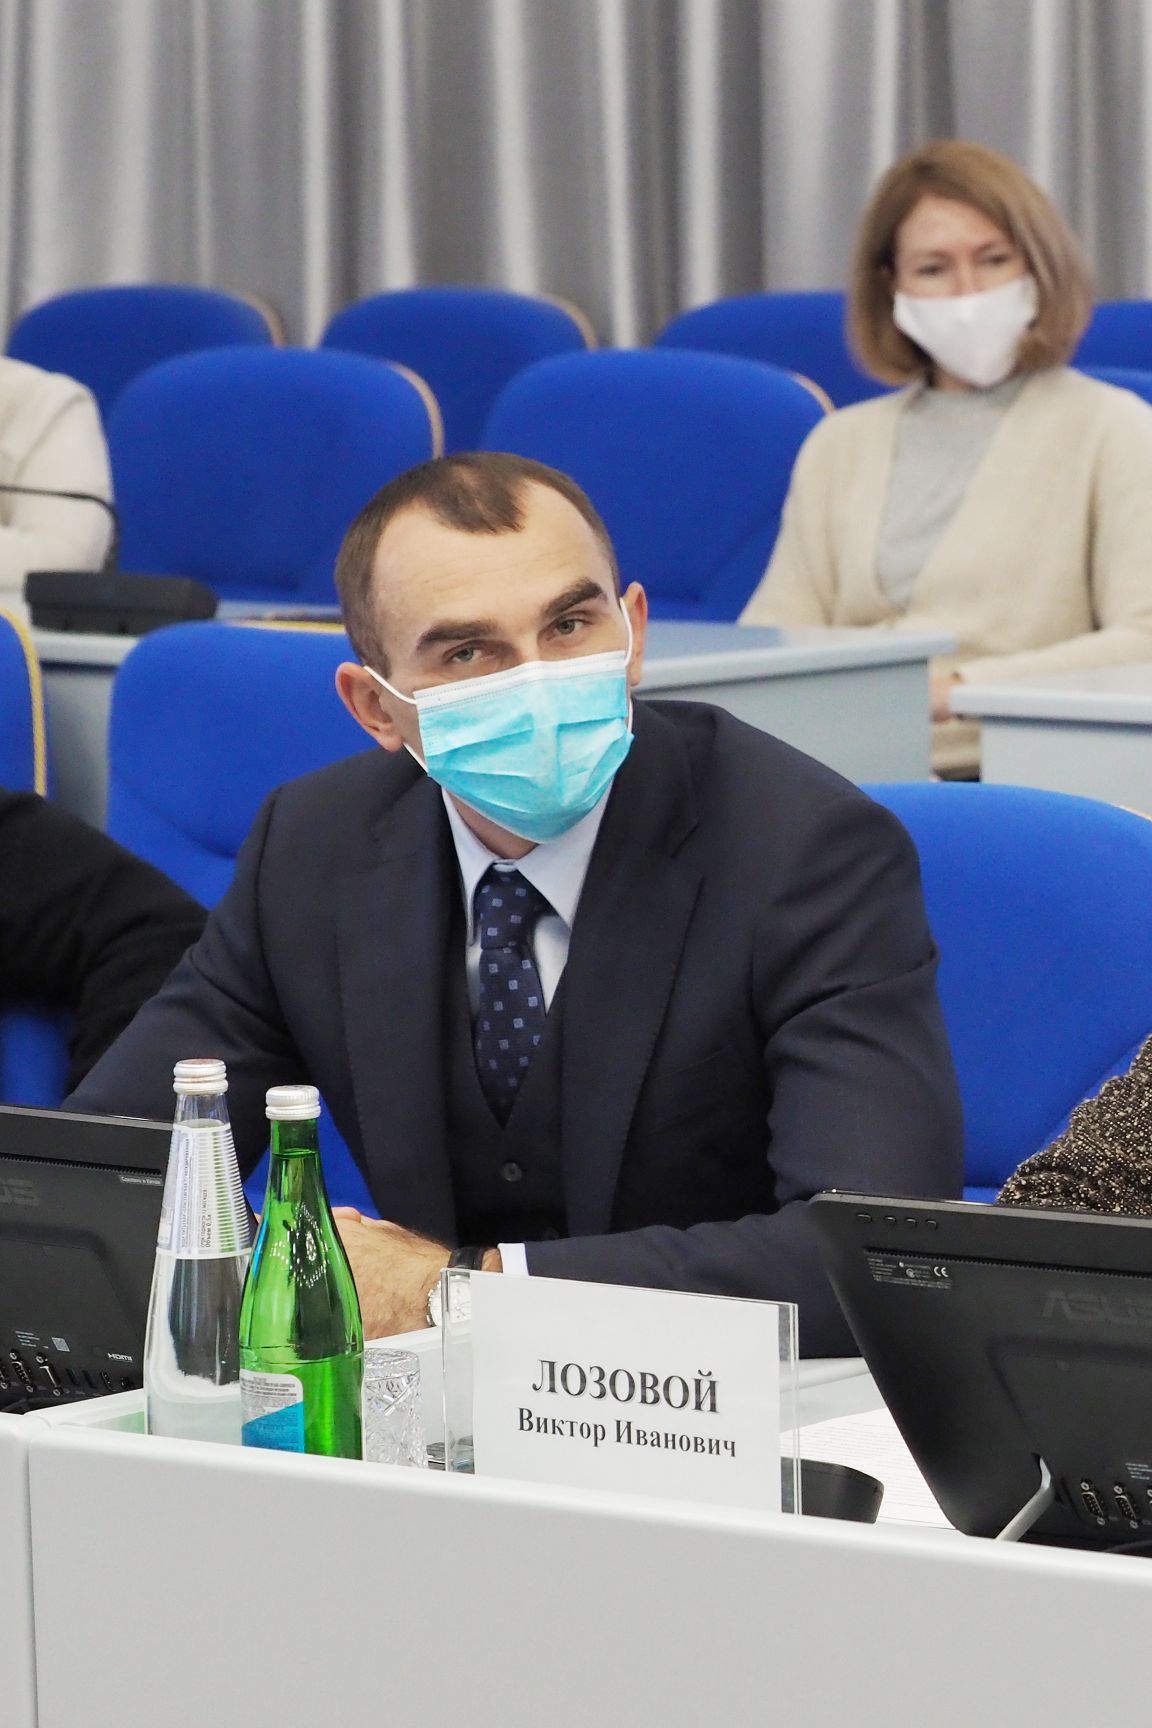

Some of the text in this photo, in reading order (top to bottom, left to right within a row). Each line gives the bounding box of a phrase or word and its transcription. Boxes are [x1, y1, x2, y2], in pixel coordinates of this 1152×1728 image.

[107, 1352, 133, 1363] HDMI
[532, 1360, 719, 1413] ЛОЗОВОЙ
[517, 1407, 737, 1458] Виктор Иванович
